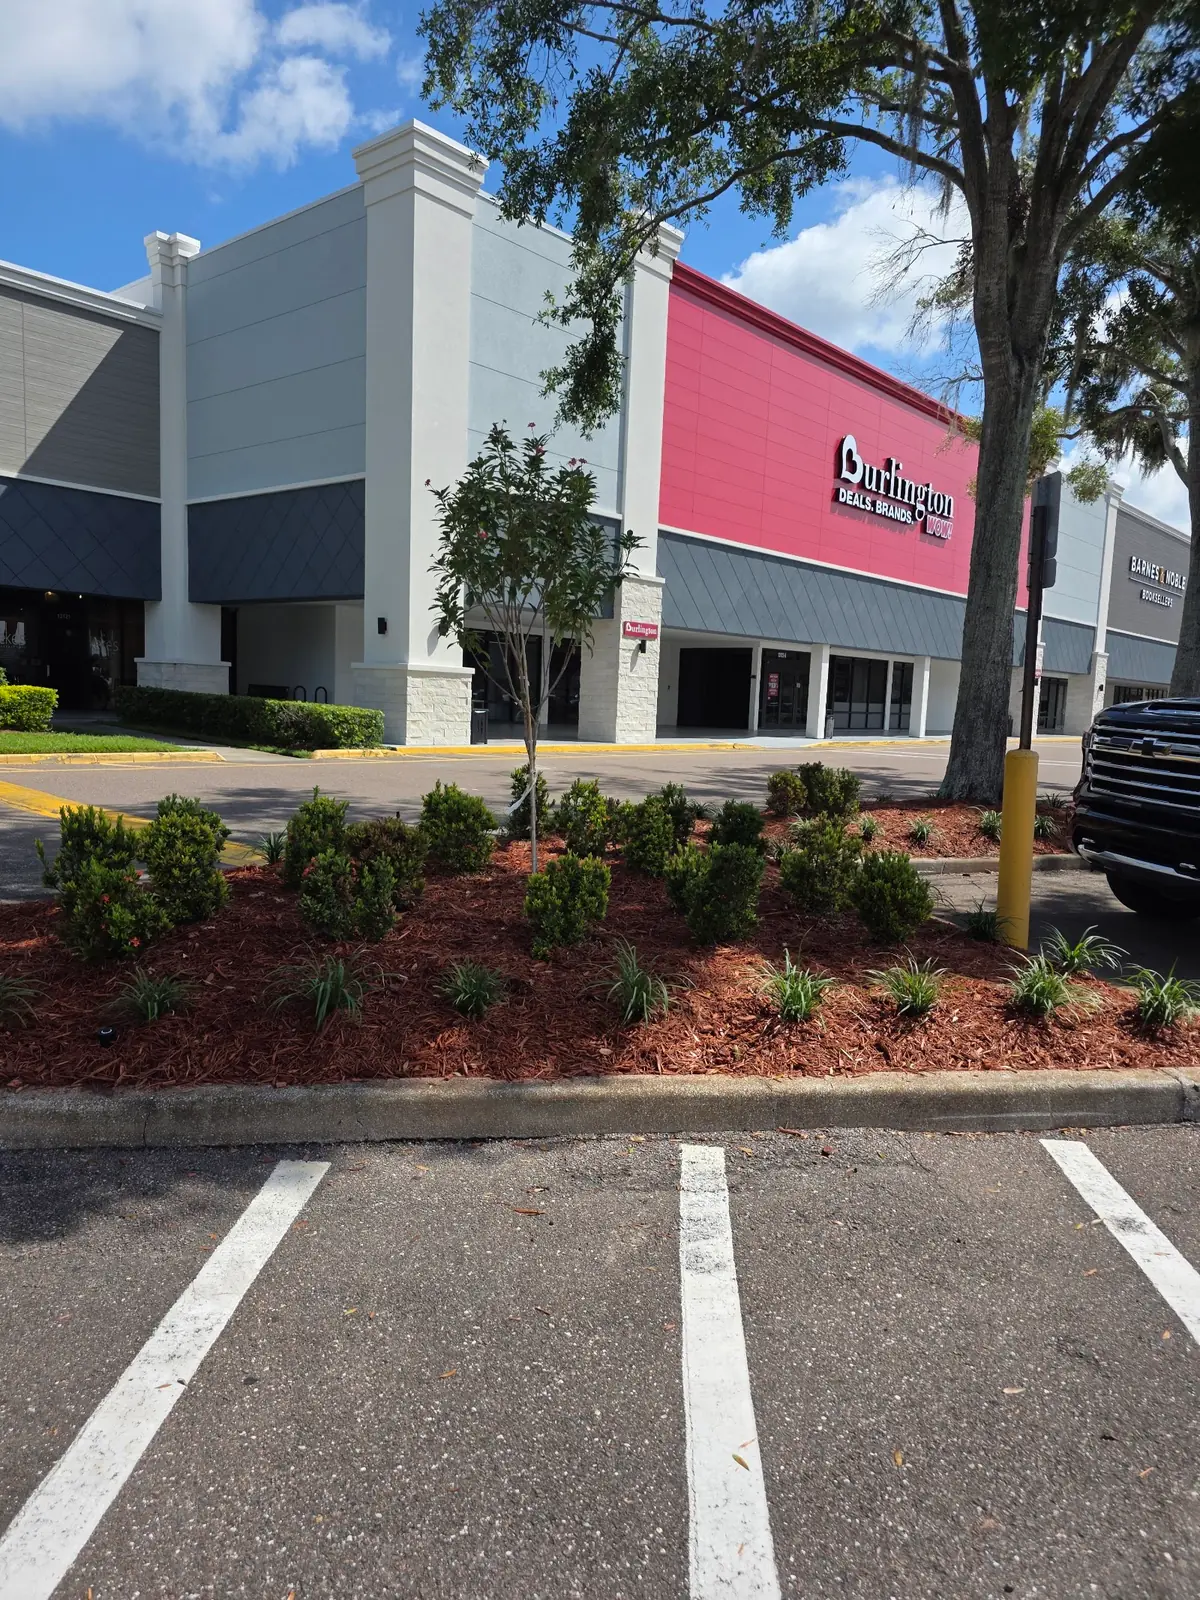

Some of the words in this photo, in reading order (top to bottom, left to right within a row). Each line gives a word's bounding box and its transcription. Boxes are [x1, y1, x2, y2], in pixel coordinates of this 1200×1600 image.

[840, 434, 954, 521] Burlington
[839, 488, 874, 511] DEALS.
[875, 500, 914, 524] BRANDS.
[926, 515, 953, 539] WOW!
[1131, 556, 1159, 580] BARNES
[1165, 570, 1186, 590] NOBLE
[1142, 589, 1173, 607] BOOKSELLERS
[625, 622, 657, 636] Burlington
